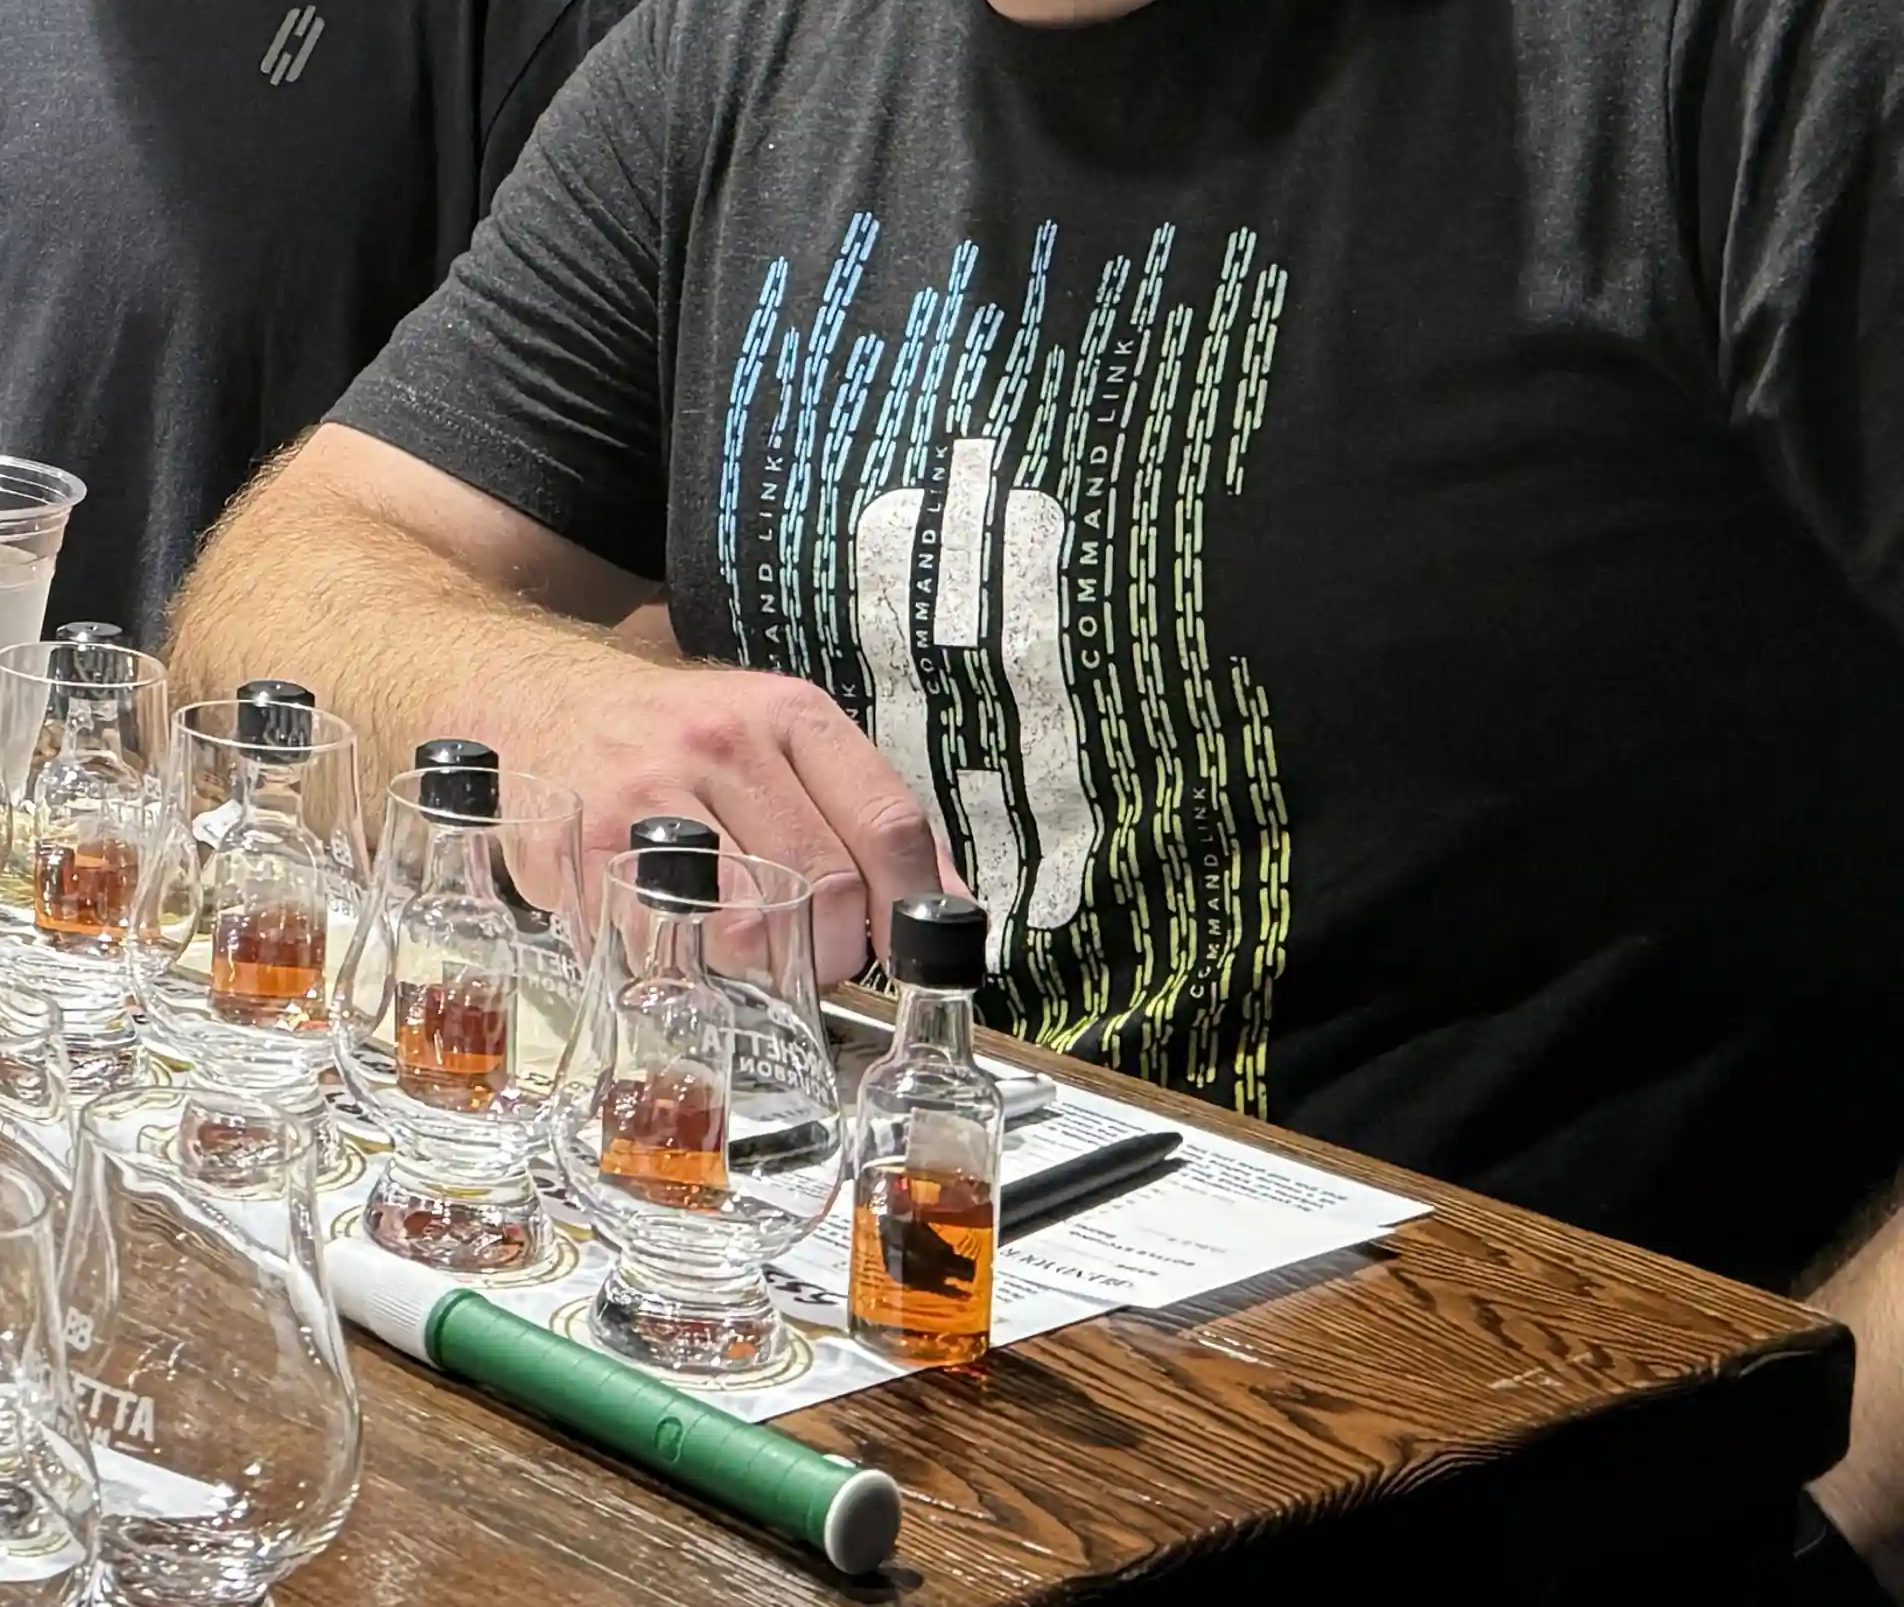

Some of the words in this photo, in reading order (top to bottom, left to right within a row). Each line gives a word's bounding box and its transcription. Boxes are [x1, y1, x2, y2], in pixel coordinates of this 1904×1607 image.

[758, 454, 784, 543] LINK
[926, 444, 948, 513] LINK
[1078, 445, 1109, 670] COMMAND
[1097, 339, 1134, 423] LINK
[915, 530, 941, 695] COMMAND
[1193, 786, 1213, 843] LINK
